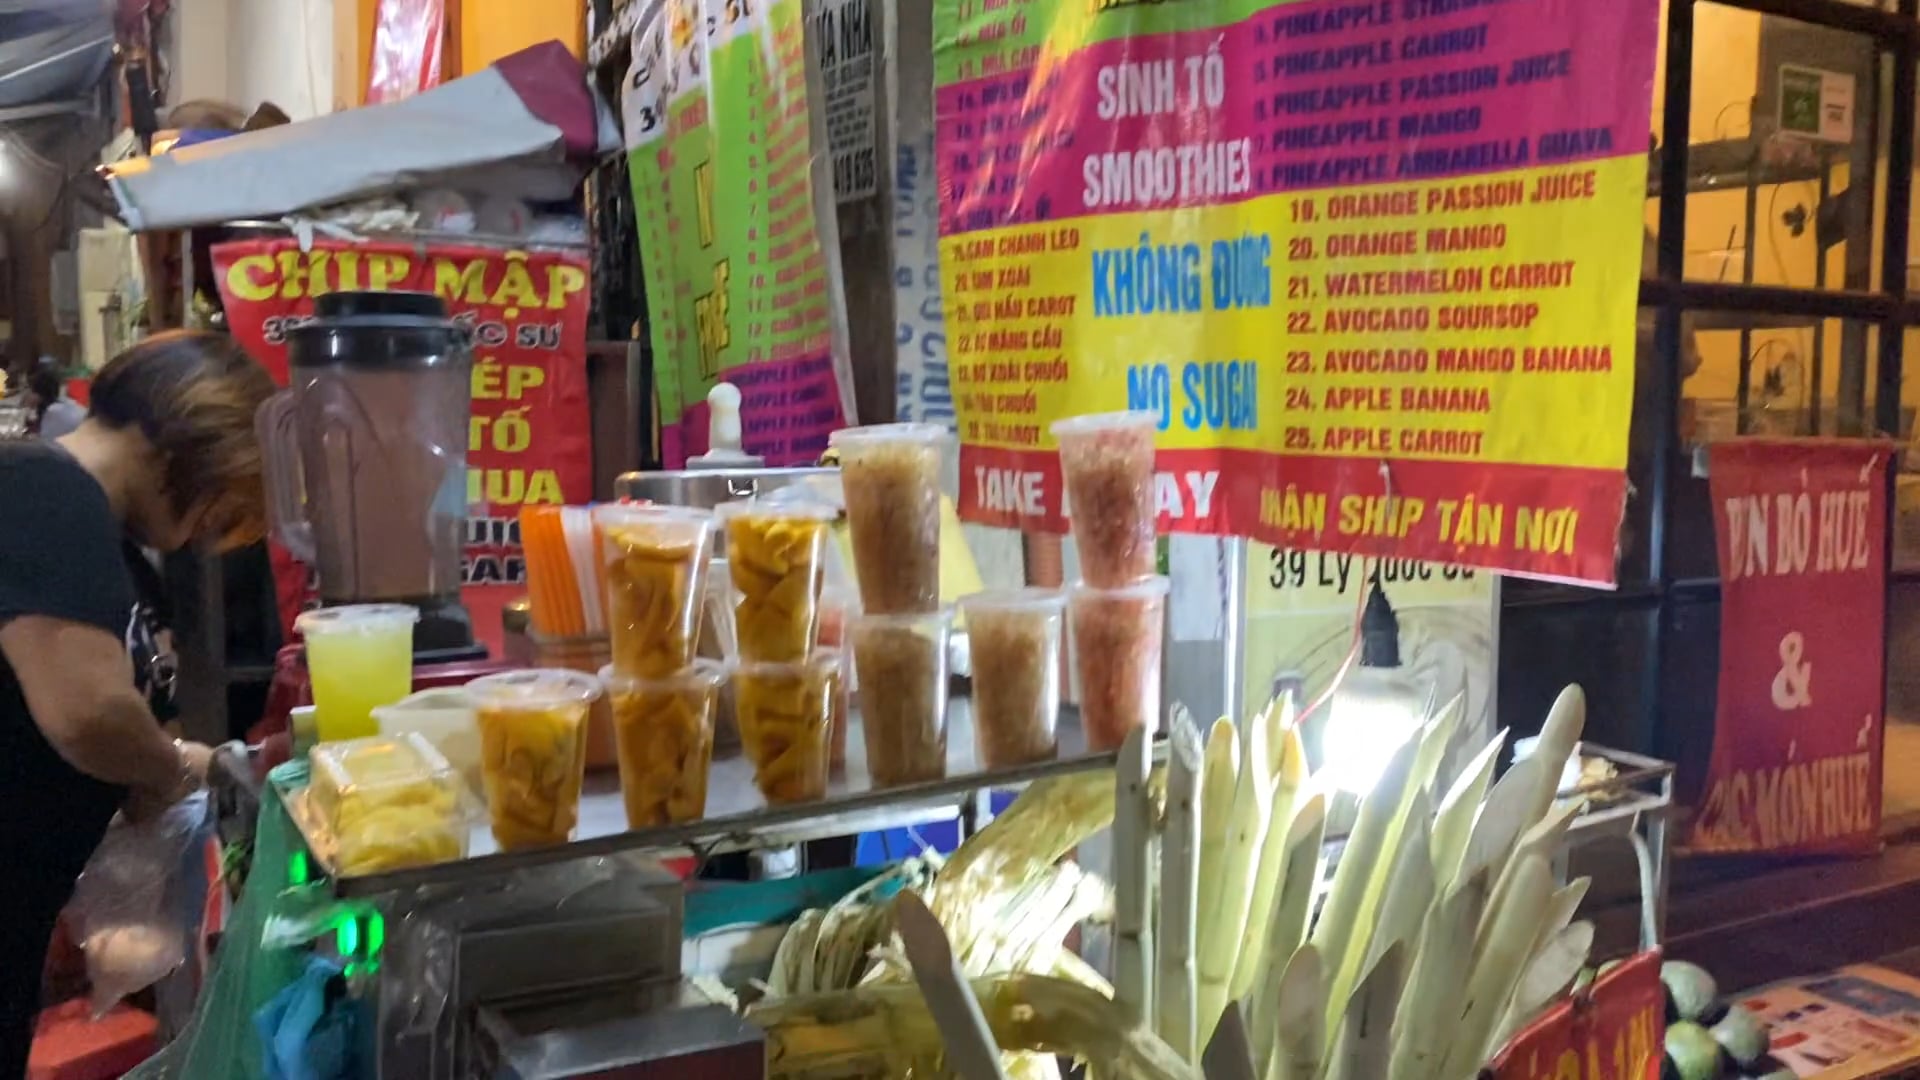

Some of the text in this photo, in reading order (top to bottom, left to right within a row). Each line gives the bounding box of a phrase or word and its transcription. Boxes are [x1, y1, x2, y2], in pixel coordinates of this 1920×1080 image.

[1273, 1, 1392, 42] PINEAPPLE
[1184, 32, 1226, 112] TỐ
[1273, 40, 1392, 78] PINEAPPLE
[1402, 23, 1489, 59] CARROT
[1273, 80, 1392, 117] PINEAPPLE
[1401, 65, 1499, 100] PASSION
[1506, 48, 1572, 85] JUICE
[1273, 116, 1389, 153] PINEAPPLE
[1399, 106, 1482, 138] MANGO
[1273, 153, 1388, 188] PINEAPPLE
[1538, 126, 1614, 160] GUAVA
[1326, 190, 1419, 222] ORANGE
[1426, 180, 1524, 215] PASSION
[1531, 169, 1597, 204] JUICE
[1051, 228, 1080, 252] LEO
[1288, 223, 1507, 262] 20. ORANGE MANGO
[226, 249, 585, 319] CHIP MẬP
[1092, 231, 1202, 318] KHÔNG
[1287, 260, 1576, 299] 21. WATERMELON CARROT
[1287, 302, 1540, 335] 22. AVOCADO SOURSOP
[1286, 344, 1612, 376] 23. AVOCADO MANGO BANANA
[1127, 359, 1257, 432] NO SUGA
[1285, 386, 1491, 415] 24. APPLE BANANA
[1284, 426, 1484, 456] 25. APPLE CARROT
[975, 465, 1047, 516] TAKE
[1338, 493, 1425, 539] SHIP
[1515, 506, 1579, 556] NƠI
[1270, 547, 1305, 589] 39
[1771, 631, 1813, 710] &
